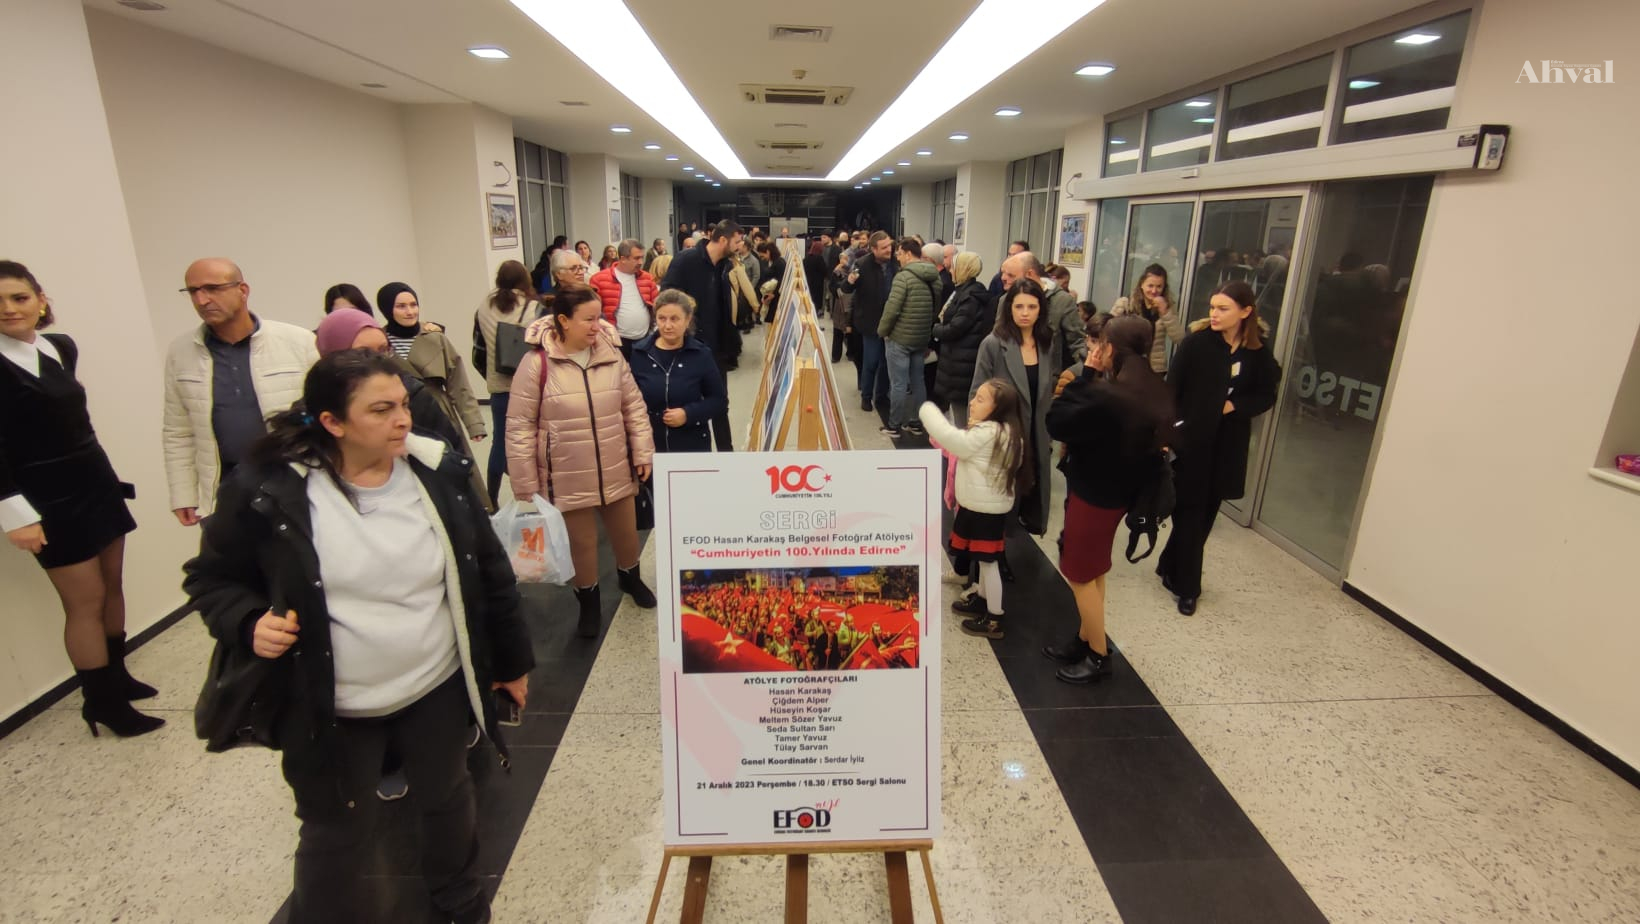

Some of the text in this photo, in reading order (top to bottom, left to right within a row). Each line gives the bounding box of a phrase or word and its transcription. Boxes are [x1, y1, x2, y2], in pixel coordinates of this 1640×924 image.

[683, 532, 913, 545] EFOD Hasan Karakaş Belgesel Fotoğraf Atölyesi
[781, 675, 858, 683] FOTOĞRAFÇILARI
[772, 697, 804, 705] Çiğdem
[774, 744, 796, 752] Tülay
[709, 781, 732, 789] Aralık
[757, 780, 797, 788] Perşembe
[856, 778, 877, 786] Sergi
[774, 807, 831, 828] EFOD
